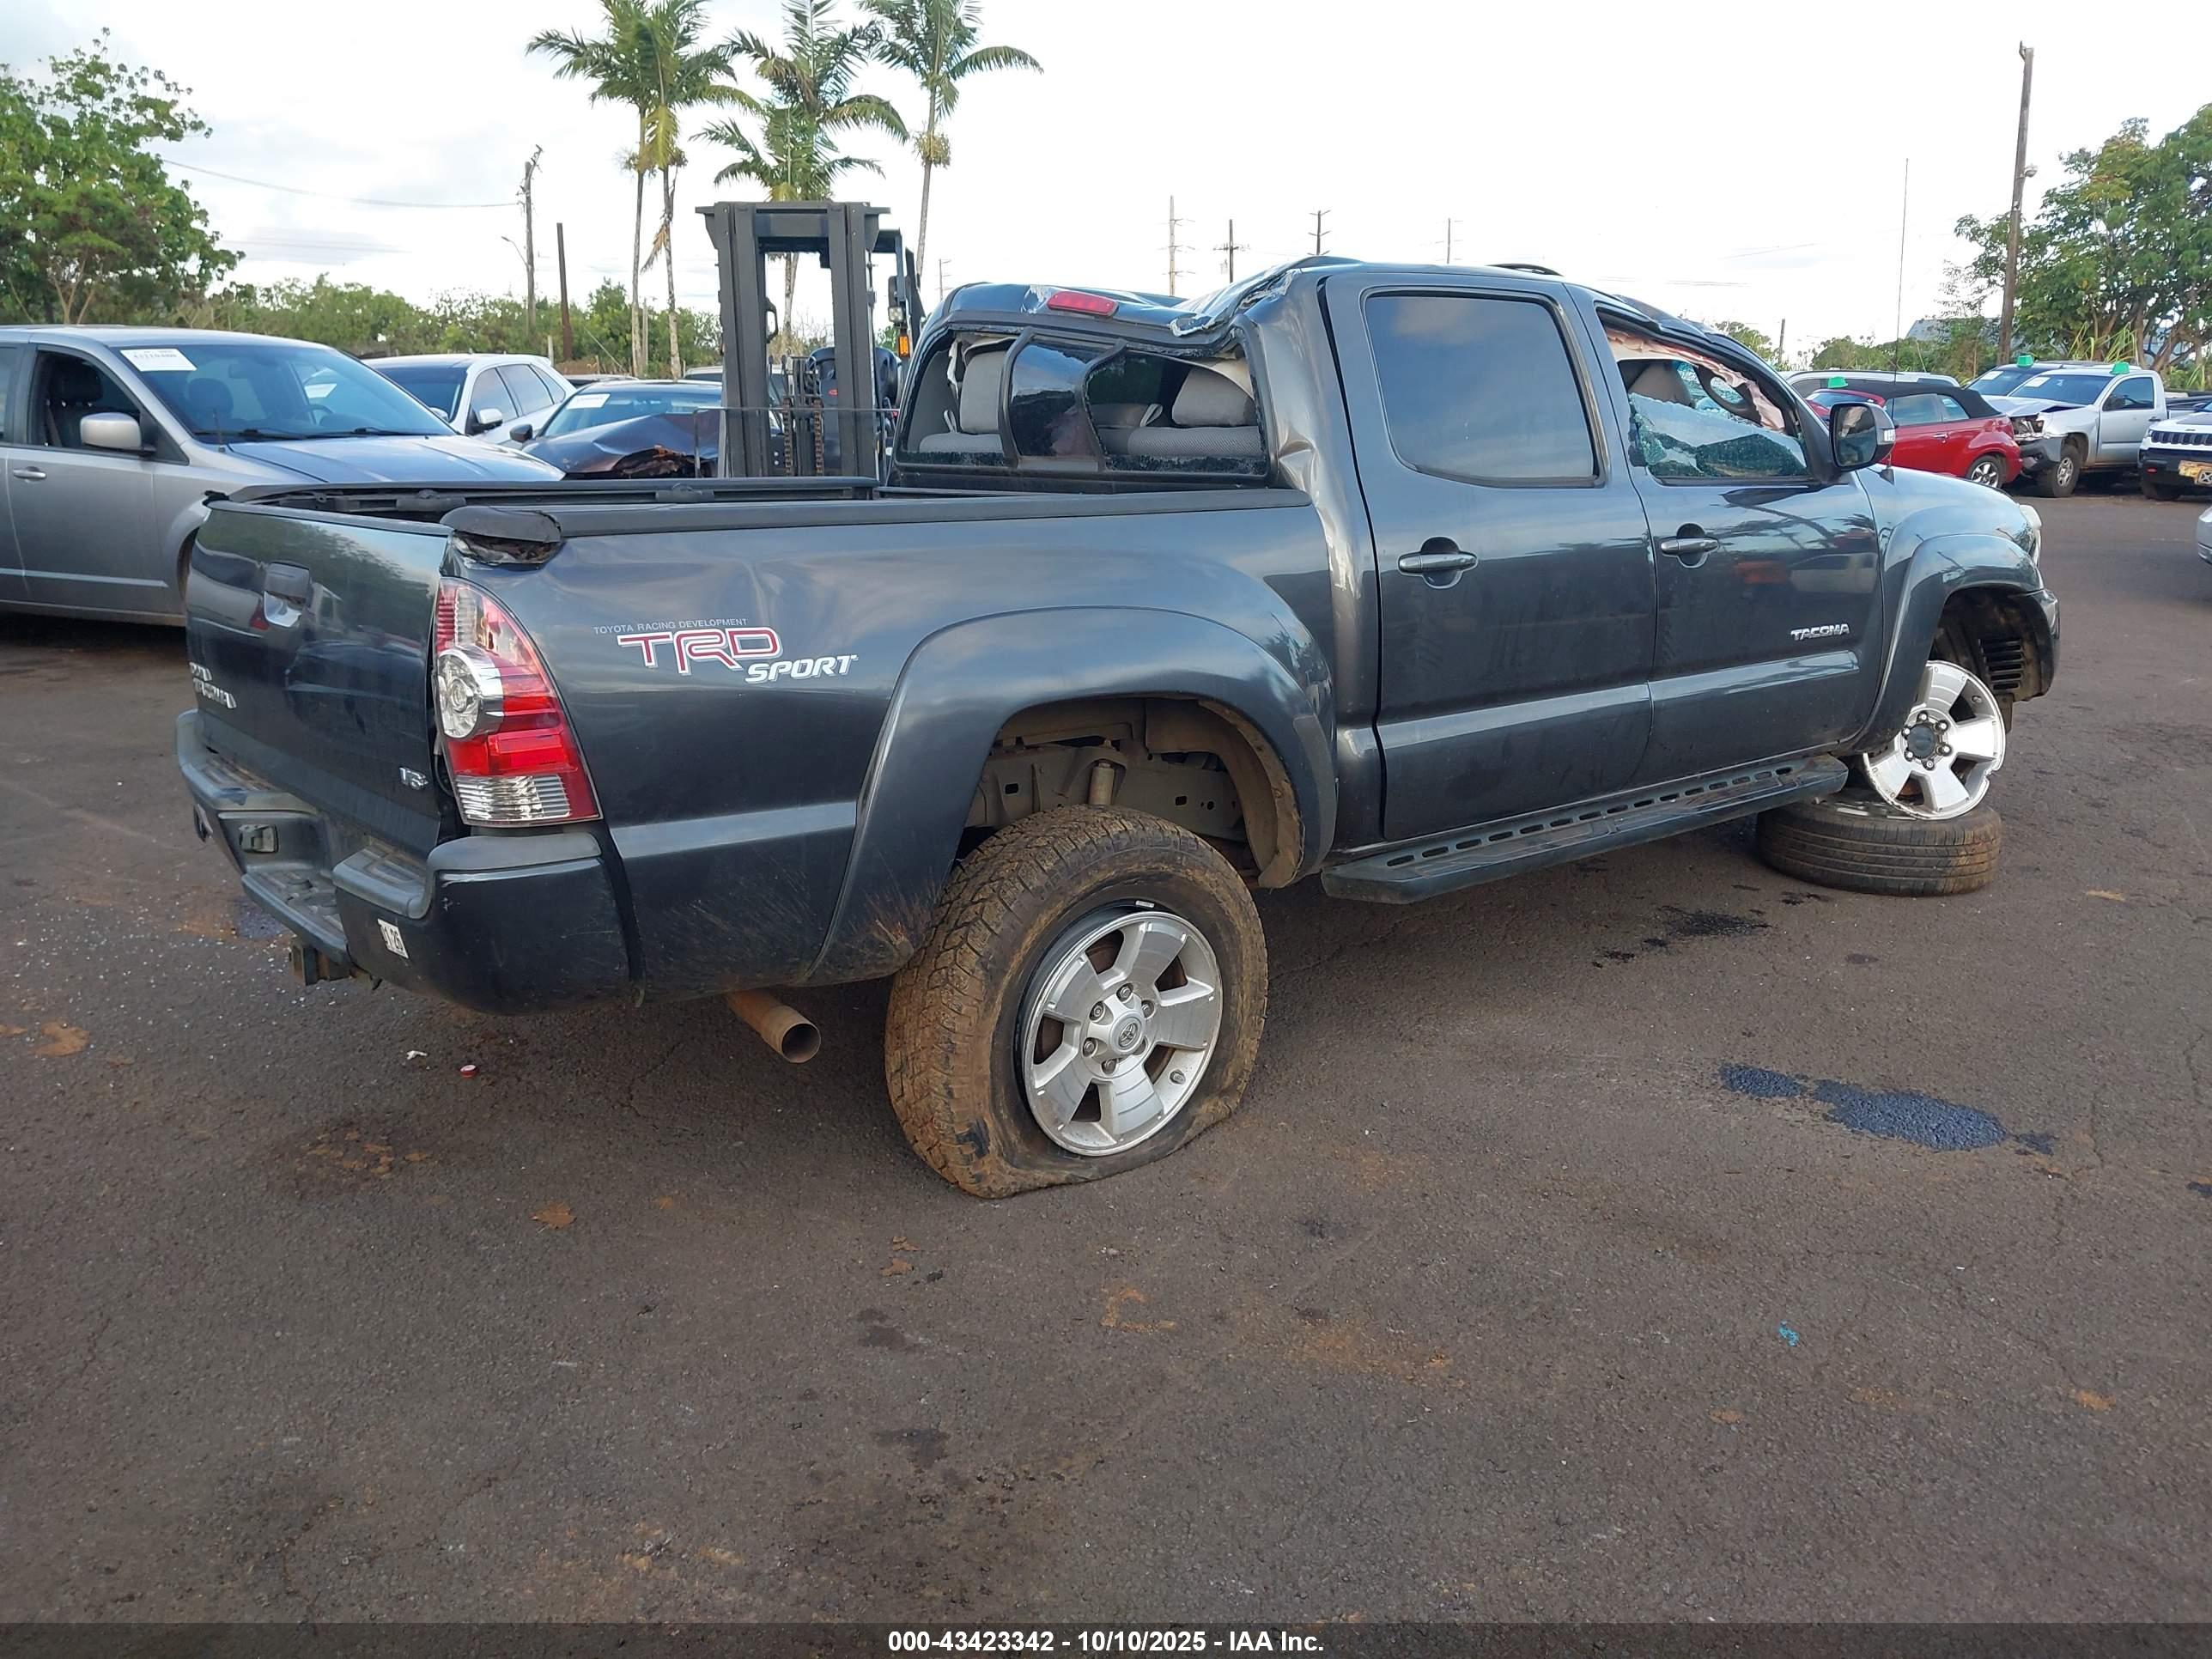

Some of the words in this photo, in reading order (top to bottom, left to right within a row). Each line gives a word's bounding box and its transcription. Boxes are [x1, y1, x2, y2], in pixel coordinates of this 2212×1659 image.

[593, 624, 634, 635] TOYOTA
[637, 621, 676, 632] RACING
[678, 618, 749, 629] DEVELOPMENT
[1790, 623, 1850, 641] TACOMA
[617, 627, 783, 675] TRD
[744, 653, 859, 684] SPORT
